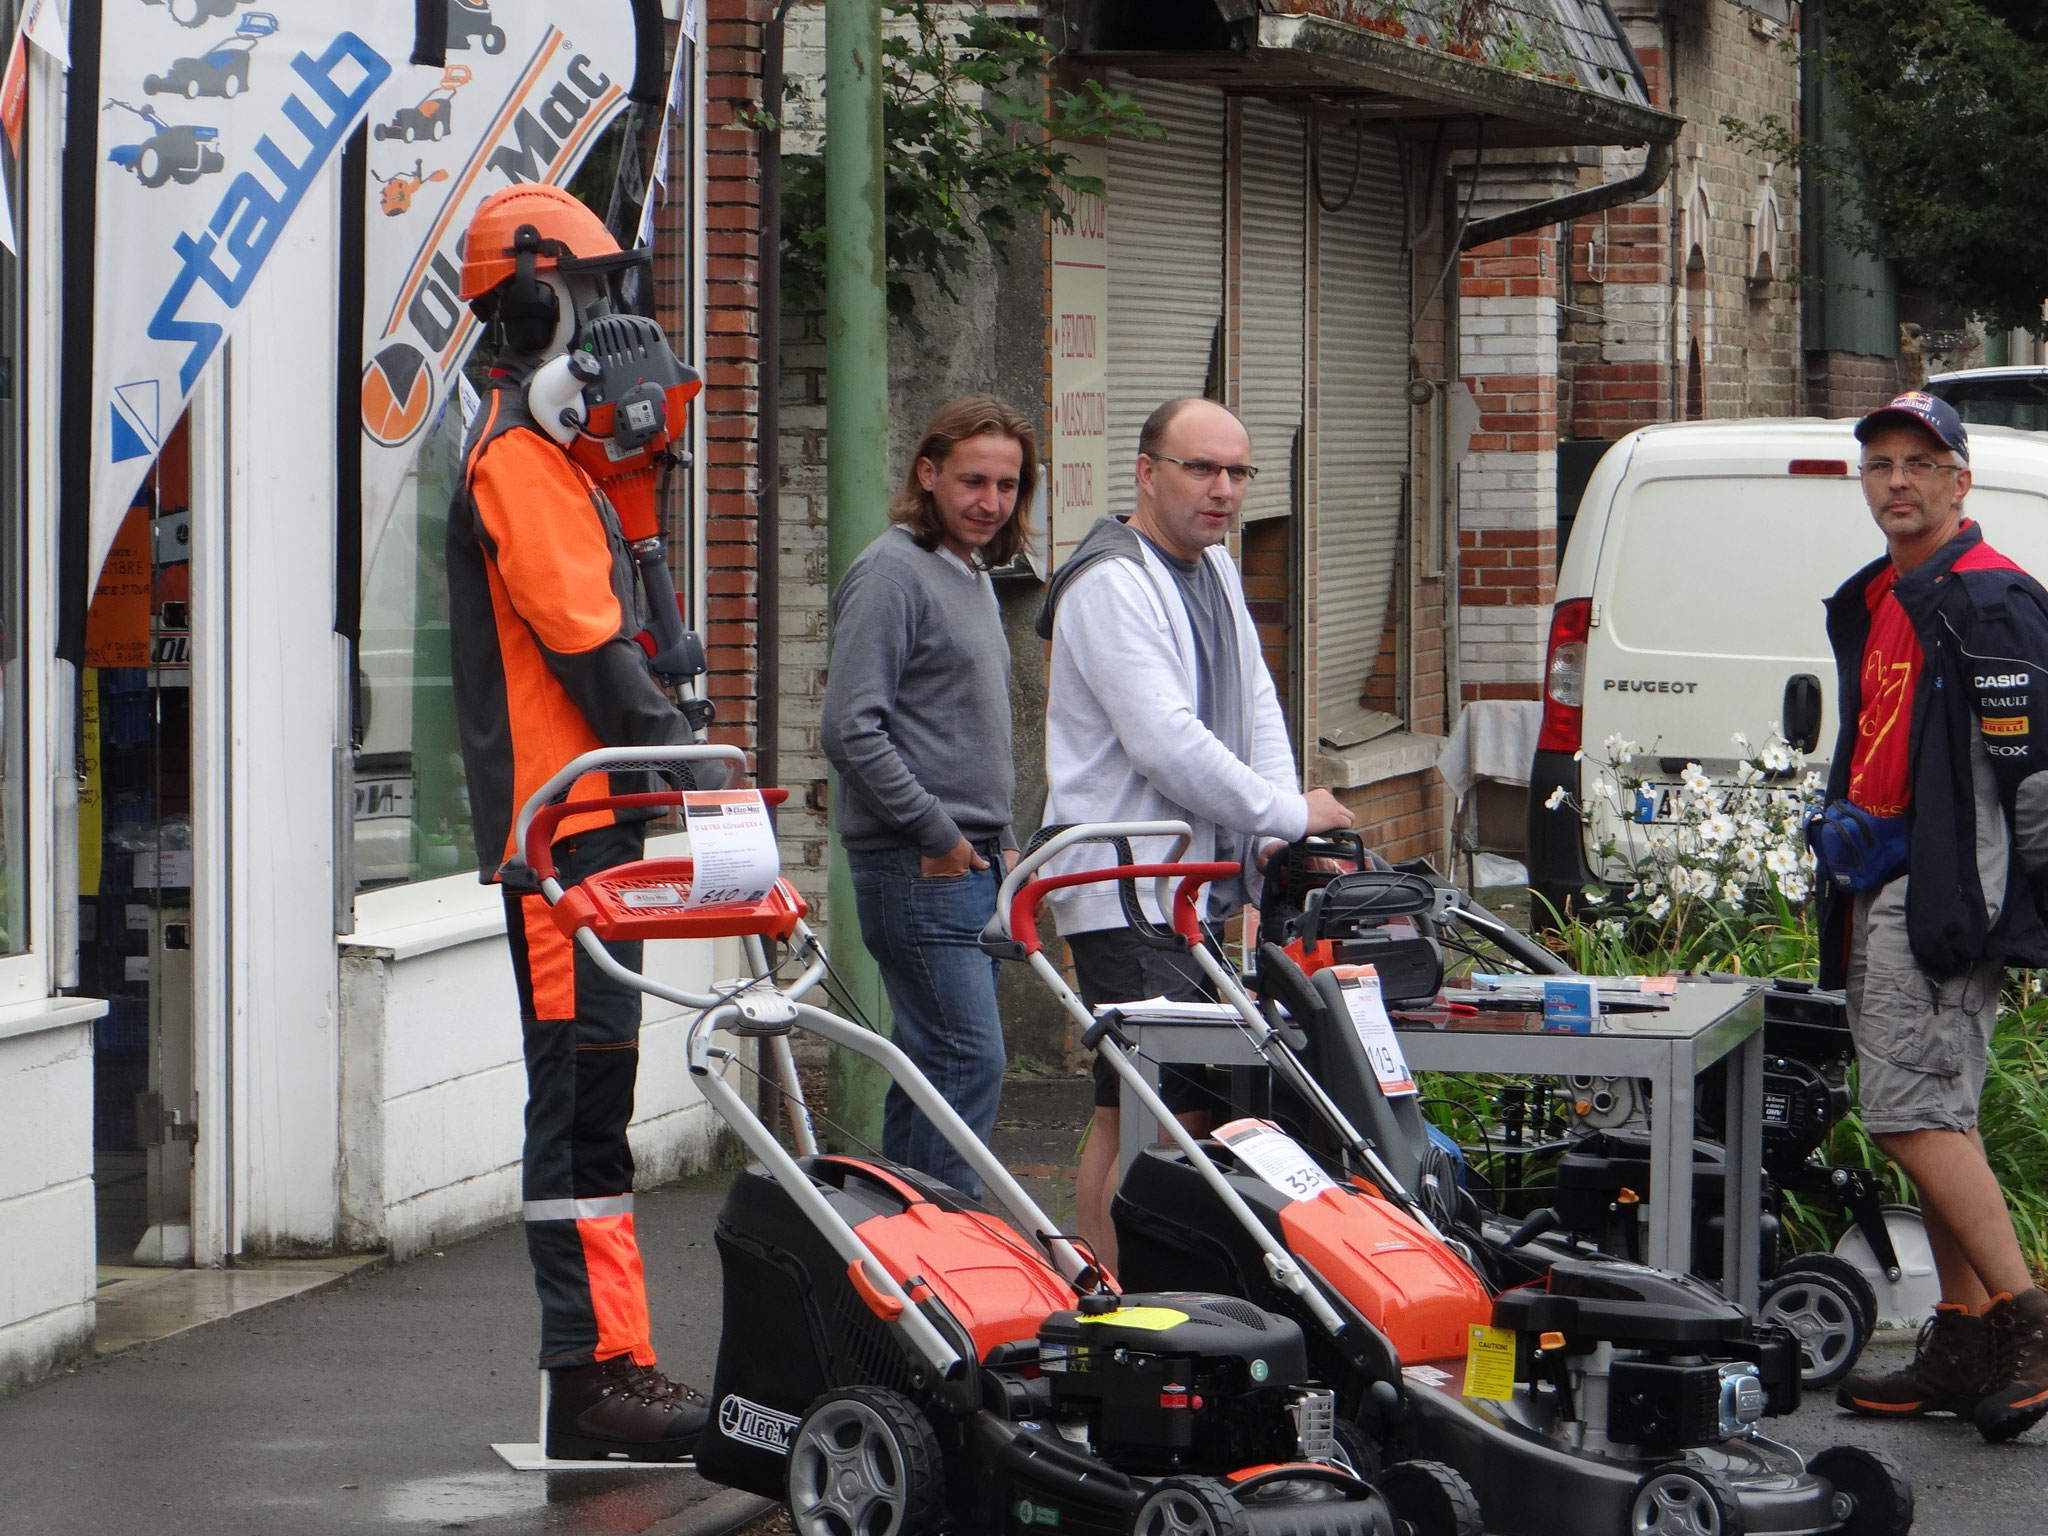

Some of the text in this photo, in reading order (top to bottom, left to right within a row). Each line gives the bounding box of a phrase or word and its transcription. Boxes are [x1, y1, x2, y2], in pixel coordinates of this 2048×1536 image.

[485, 53, 610, 185] Mac
[147, 31, 392, 400] Staub
[1061, 314, 1096, 358] FEMININ
[1061, 392, 1105, 436] MASCULIN
[1061, 461, 1093, 514] JUNIOR
[1603, 679, 1698, 694] PEUGEOT
[1974, 673, 2029, 688] CASIO
[1980, 695, 2028, 707] ENAULT
[1478, 1341, 1508, 1351] CAUTION!
